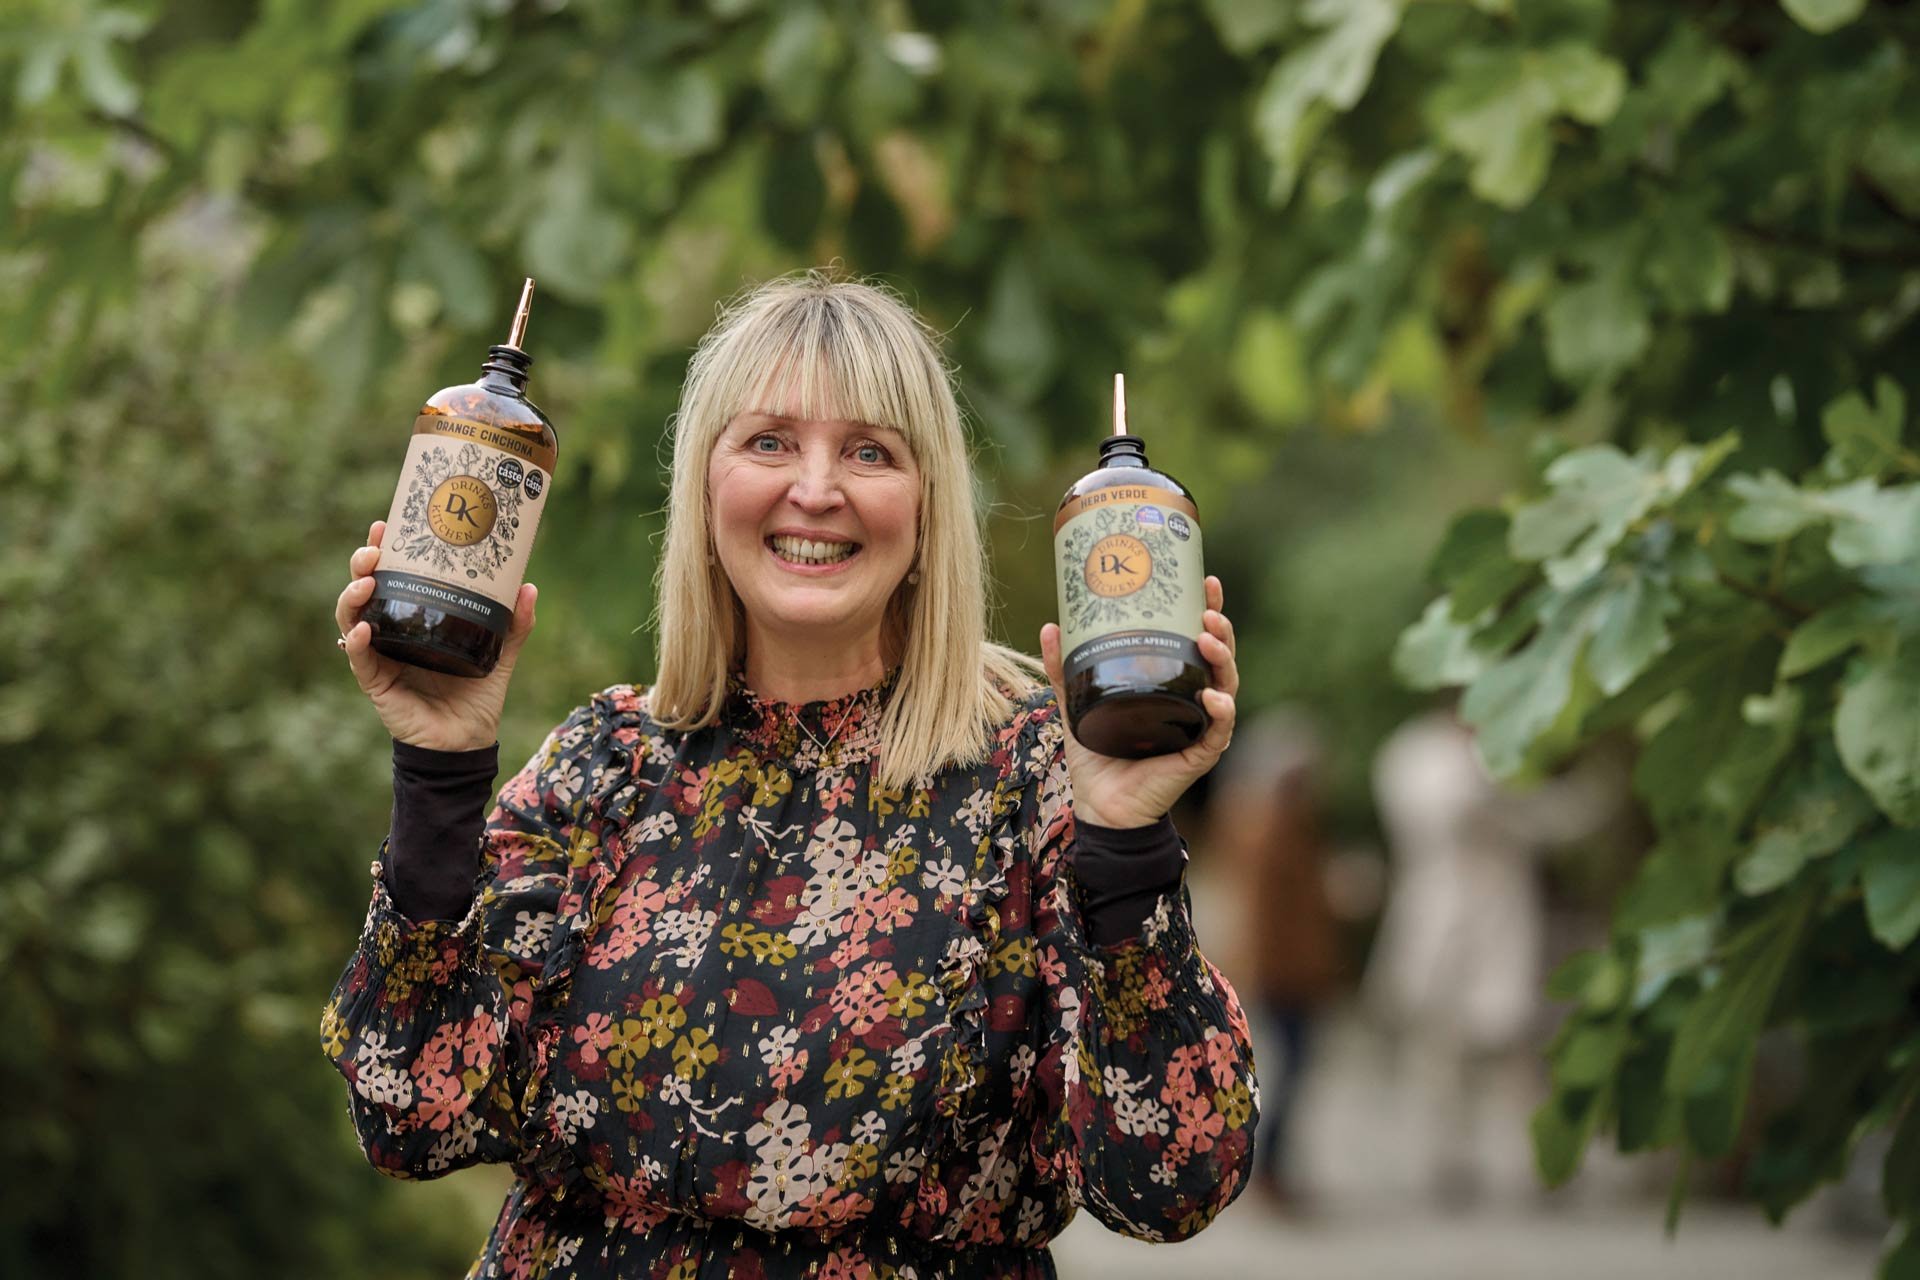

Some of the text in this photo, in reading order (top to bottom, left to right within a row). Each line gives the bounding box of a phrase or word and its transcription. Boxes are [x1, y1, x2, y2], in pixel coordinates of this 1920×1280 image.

[436, 420, 533, 457] ORANGE CINCHONA
[498, 466, 522, 483] taste
[525, 478, 542, 493] taste
[451, 480, 491, 510] DRINKS
[1081, 489, 1149, 509] HERB VERDE
[431, 504, 473, 541] KITCHEN
[445, 493, 480, 528] DK
[1100, 553, 1139, 574] DK
[387, 579, 458, 603] NON-ALCOHOLIC
[457, 597, 492, 616] APERITIF
[1073, 636, 1142, 663] NON-ALCOHOLIC
